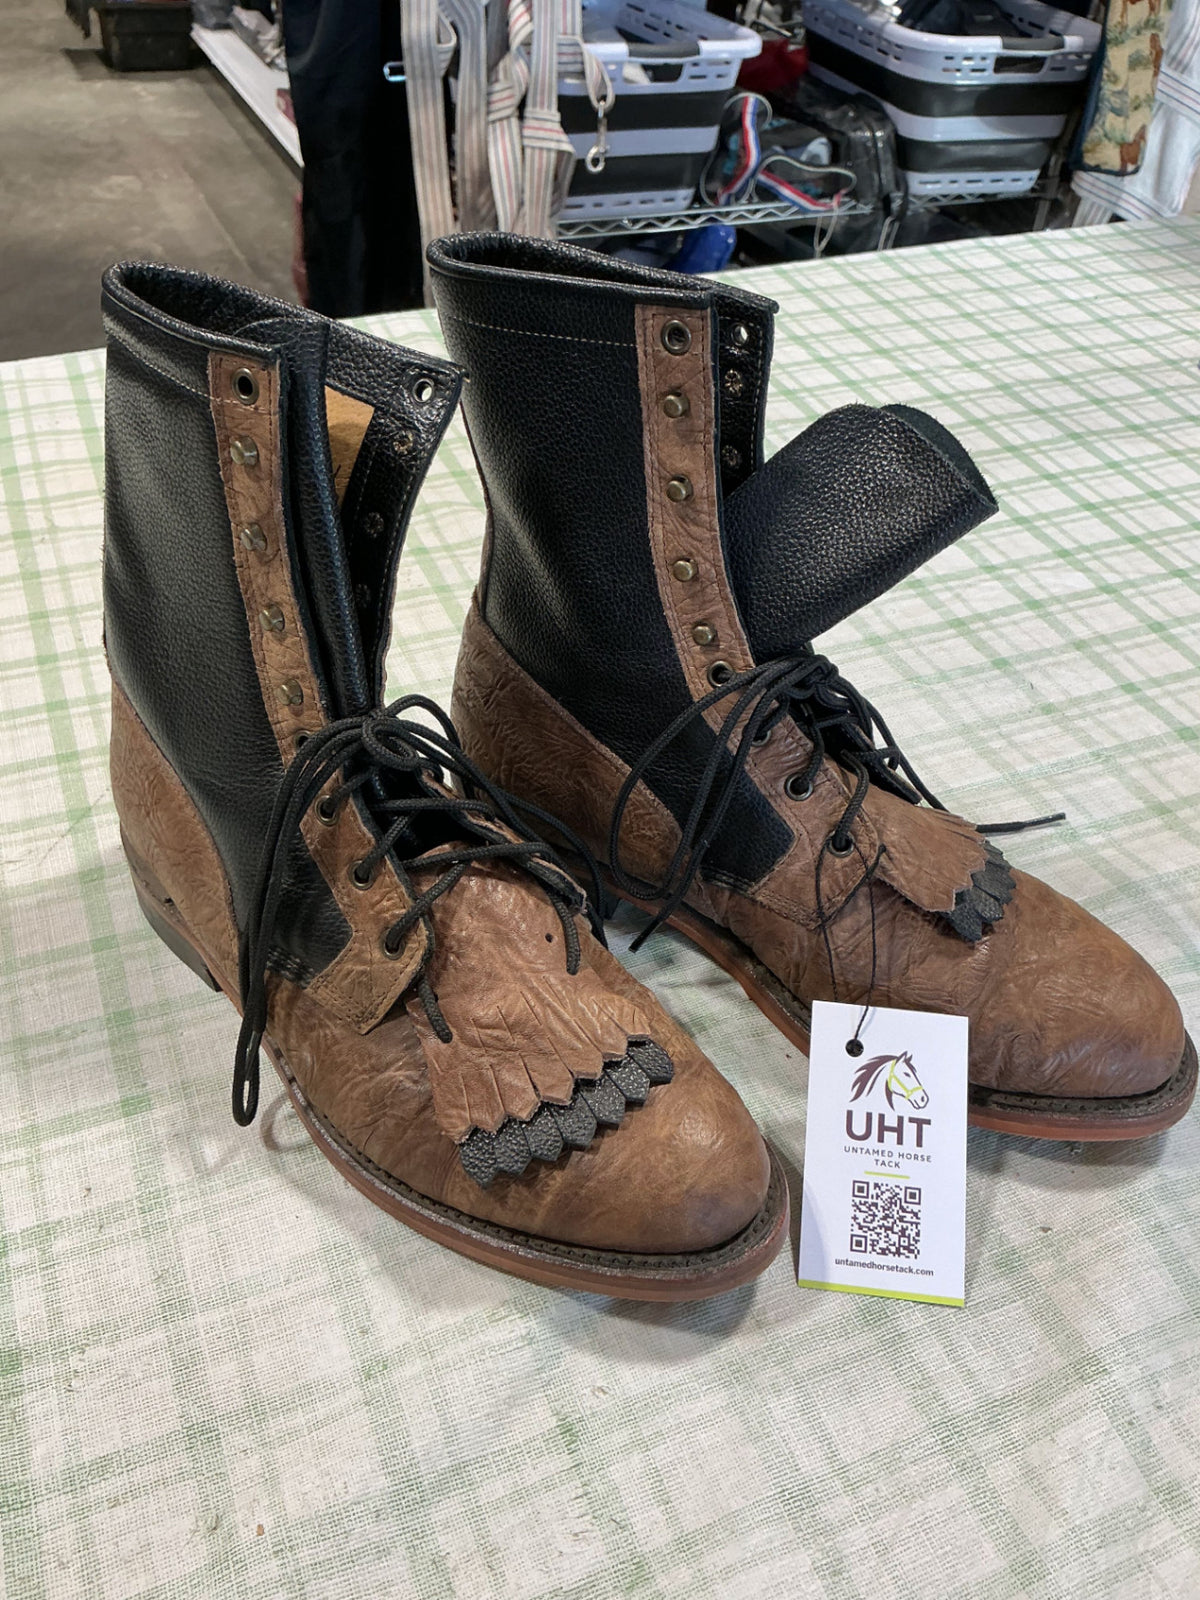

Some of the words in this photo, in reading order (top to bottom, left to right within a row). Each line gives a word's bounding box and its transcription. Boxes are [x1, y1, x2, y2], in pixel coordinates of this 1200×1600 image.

[846, 1110, 931, 1148] UHT
[844, 1146, 894, 1158] UNTAMED
[898, 1152, 932, 1163] HORSE
[874, 1159, 901, 1169] TACK
[835, 1258, 934, 1277] untamedhorsetack.com
